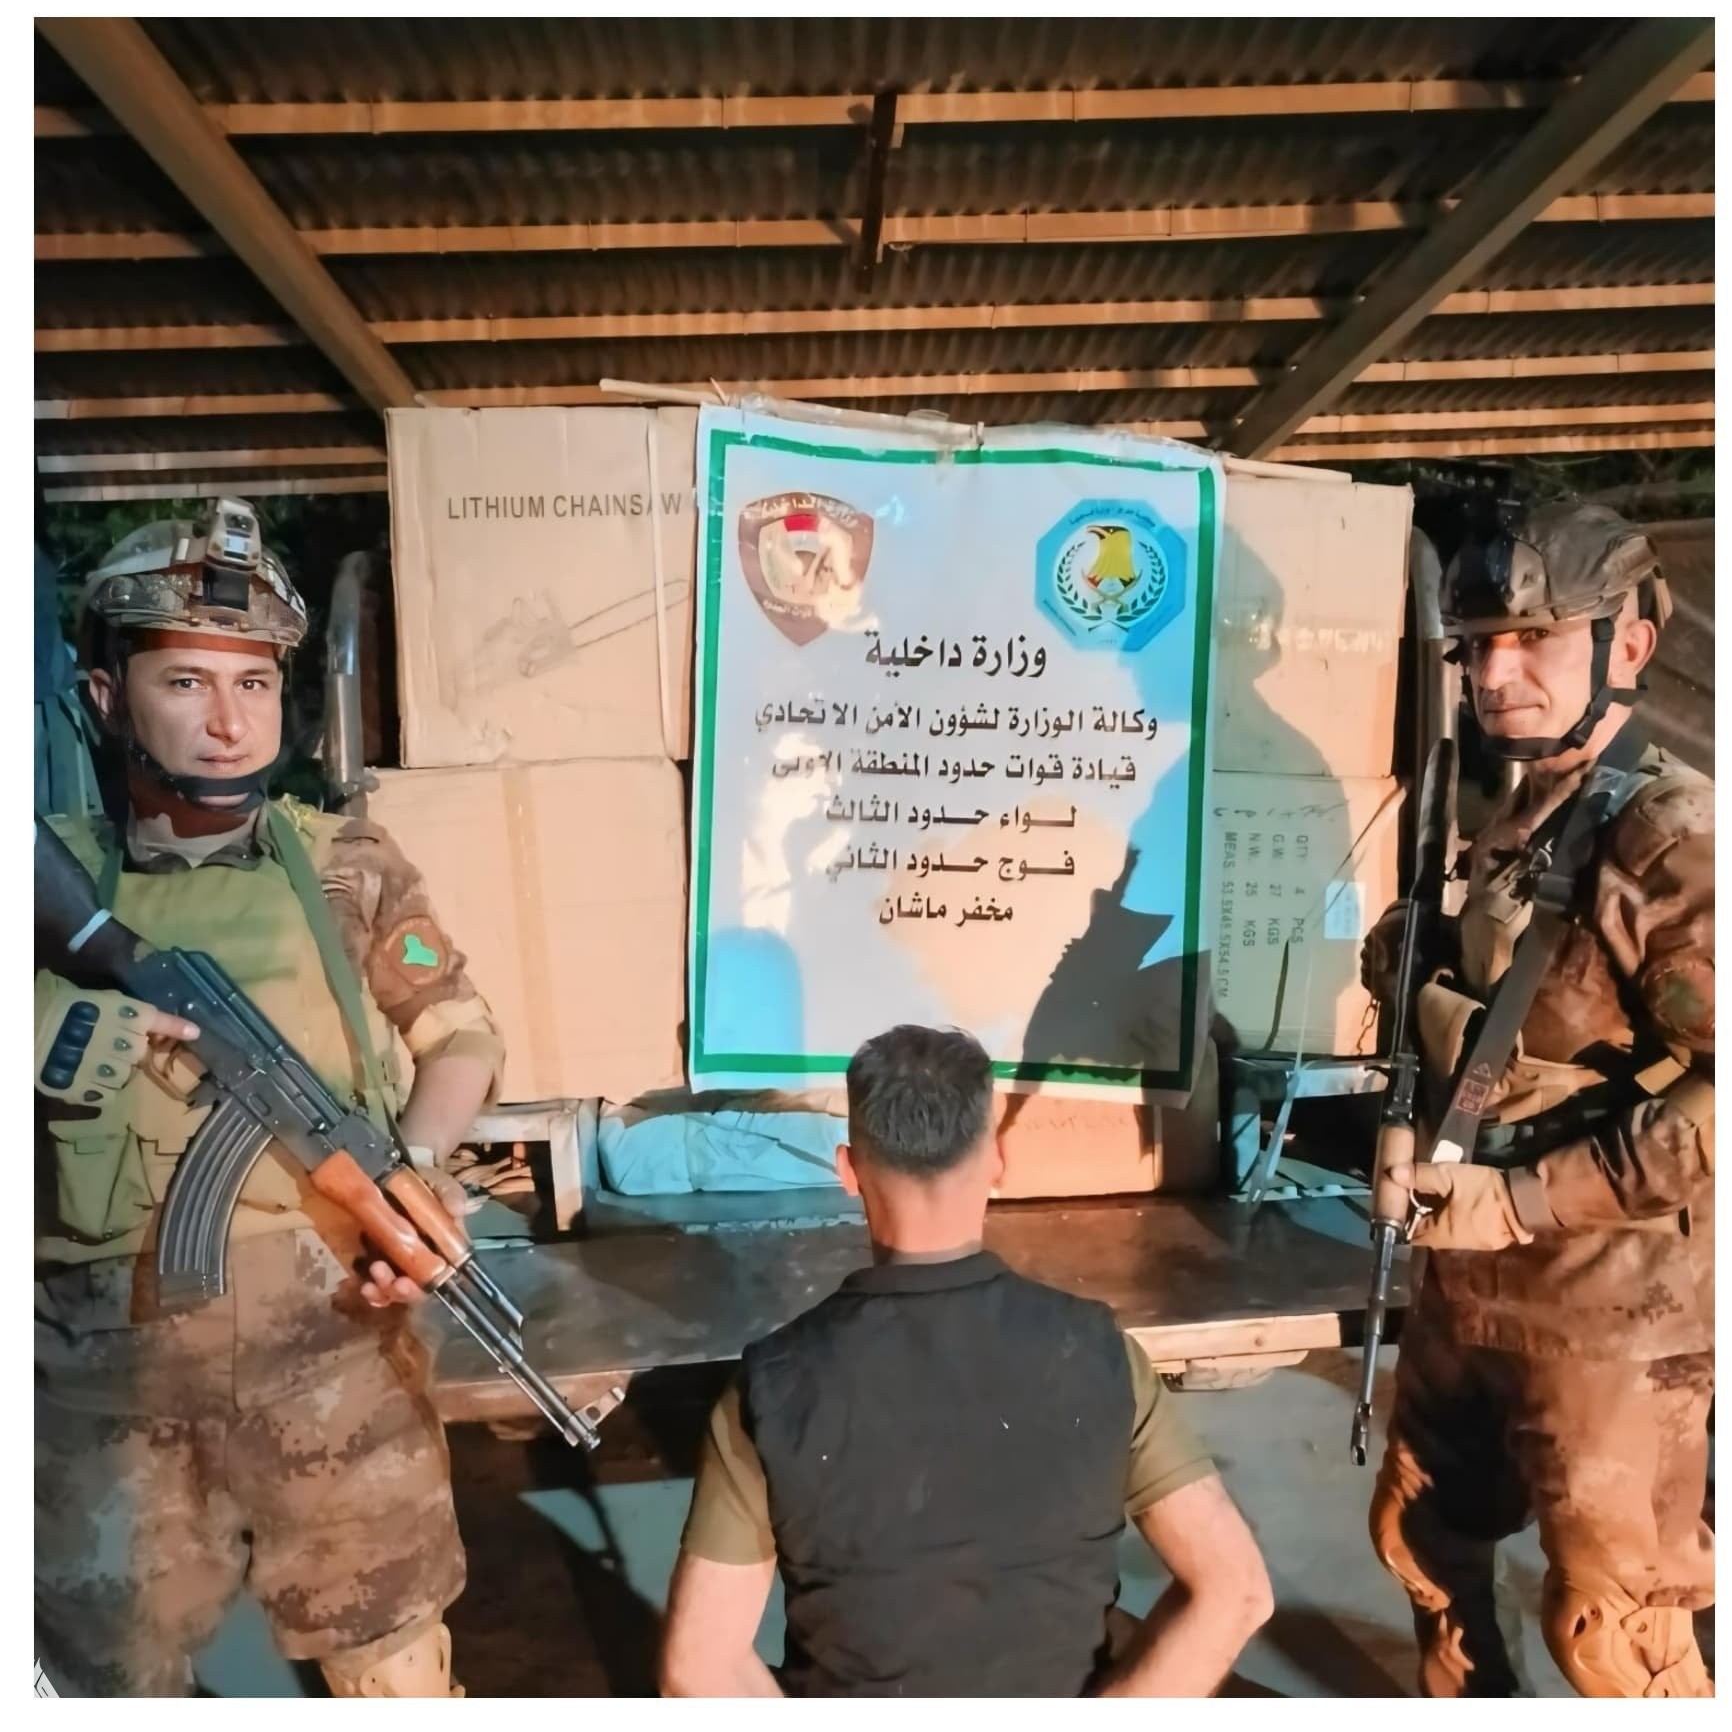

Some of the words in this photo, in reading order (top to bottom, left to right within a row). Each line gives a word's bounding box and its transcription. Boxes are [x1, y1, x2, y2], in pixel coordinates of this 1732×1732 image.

[448, 495, 545, 520] LITHIUM
[864, 631, 962, 678] داخلية
[972, 634, 1047, 678] وزارة
[865, 703, 921, 734] الأمن
[929, 702, 1000, 737] لشؤون
[1007, 707, 1083, 739] الوزارة
[1092, 706, 1158, 741] وكالة
[852, 750, 929, 777] المنطقة
[938, 758, 996, 784] حدود
[1005, 753, 1064, 786] قوات
[1071, 755, 1136, 790] قيادة
[826, 794, 899, 823] الثالث
[907, 805, 990, 831] حدود
[999, 805, 1077, 831] لواء
[825, 842, 898, 885] الثاني
[906, 852, 989, 878] حدود
[998, 850, 1075, 882] فوج
[879, 891, 947, 925] ماشان
[955, 896, 1013, 928] مخفر
[1243, 920, 1256, 947] KGS
[1267, 918, 1280, 946] KGS
[1290, 917, 1305, 944] PCS
